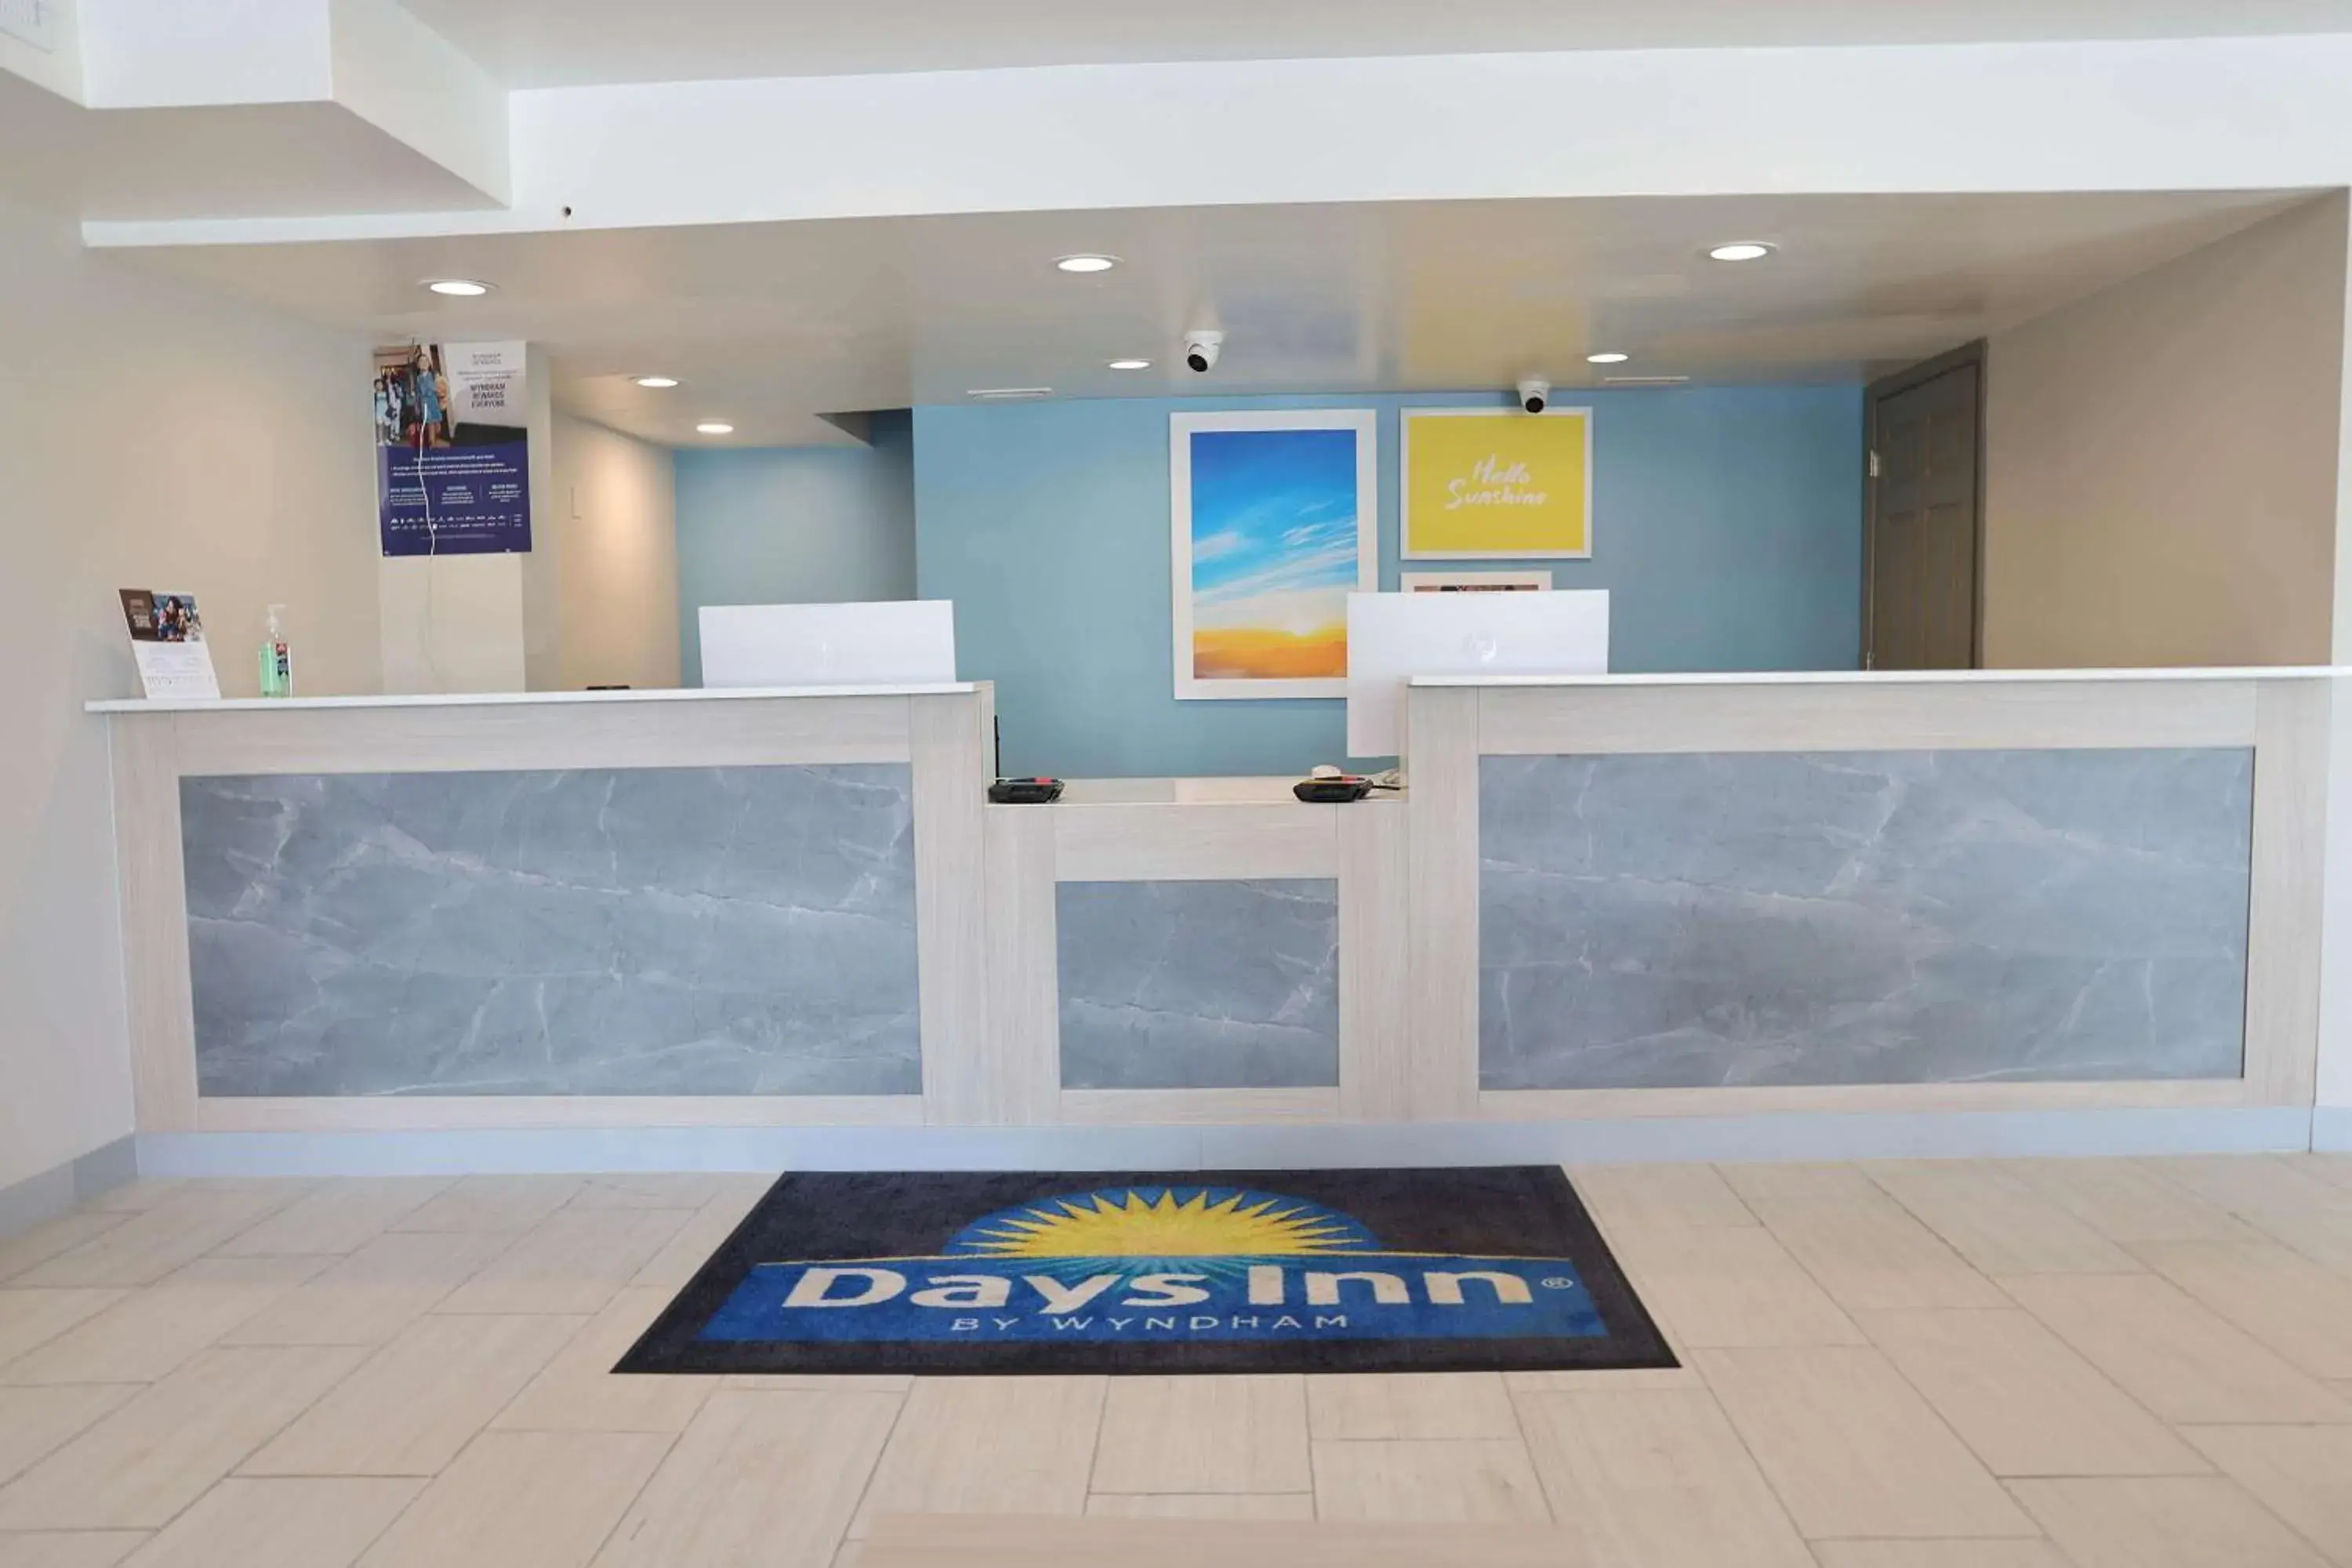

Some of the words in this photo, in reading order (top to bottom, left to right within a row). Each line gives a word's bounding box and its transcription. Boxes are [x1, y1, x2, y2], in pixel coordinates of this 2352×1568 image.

[1472, 453, 1531, 485] Hello
[1445, 477, 1549, 510] Sunshine
[782, 1267, 1210, 1315] Days
[1248, 1265, 1534, 1305] Inn
[951, 1317, 1019, 1330] BY
[1052, 1314, 1348, 1330] WYNDHAM
